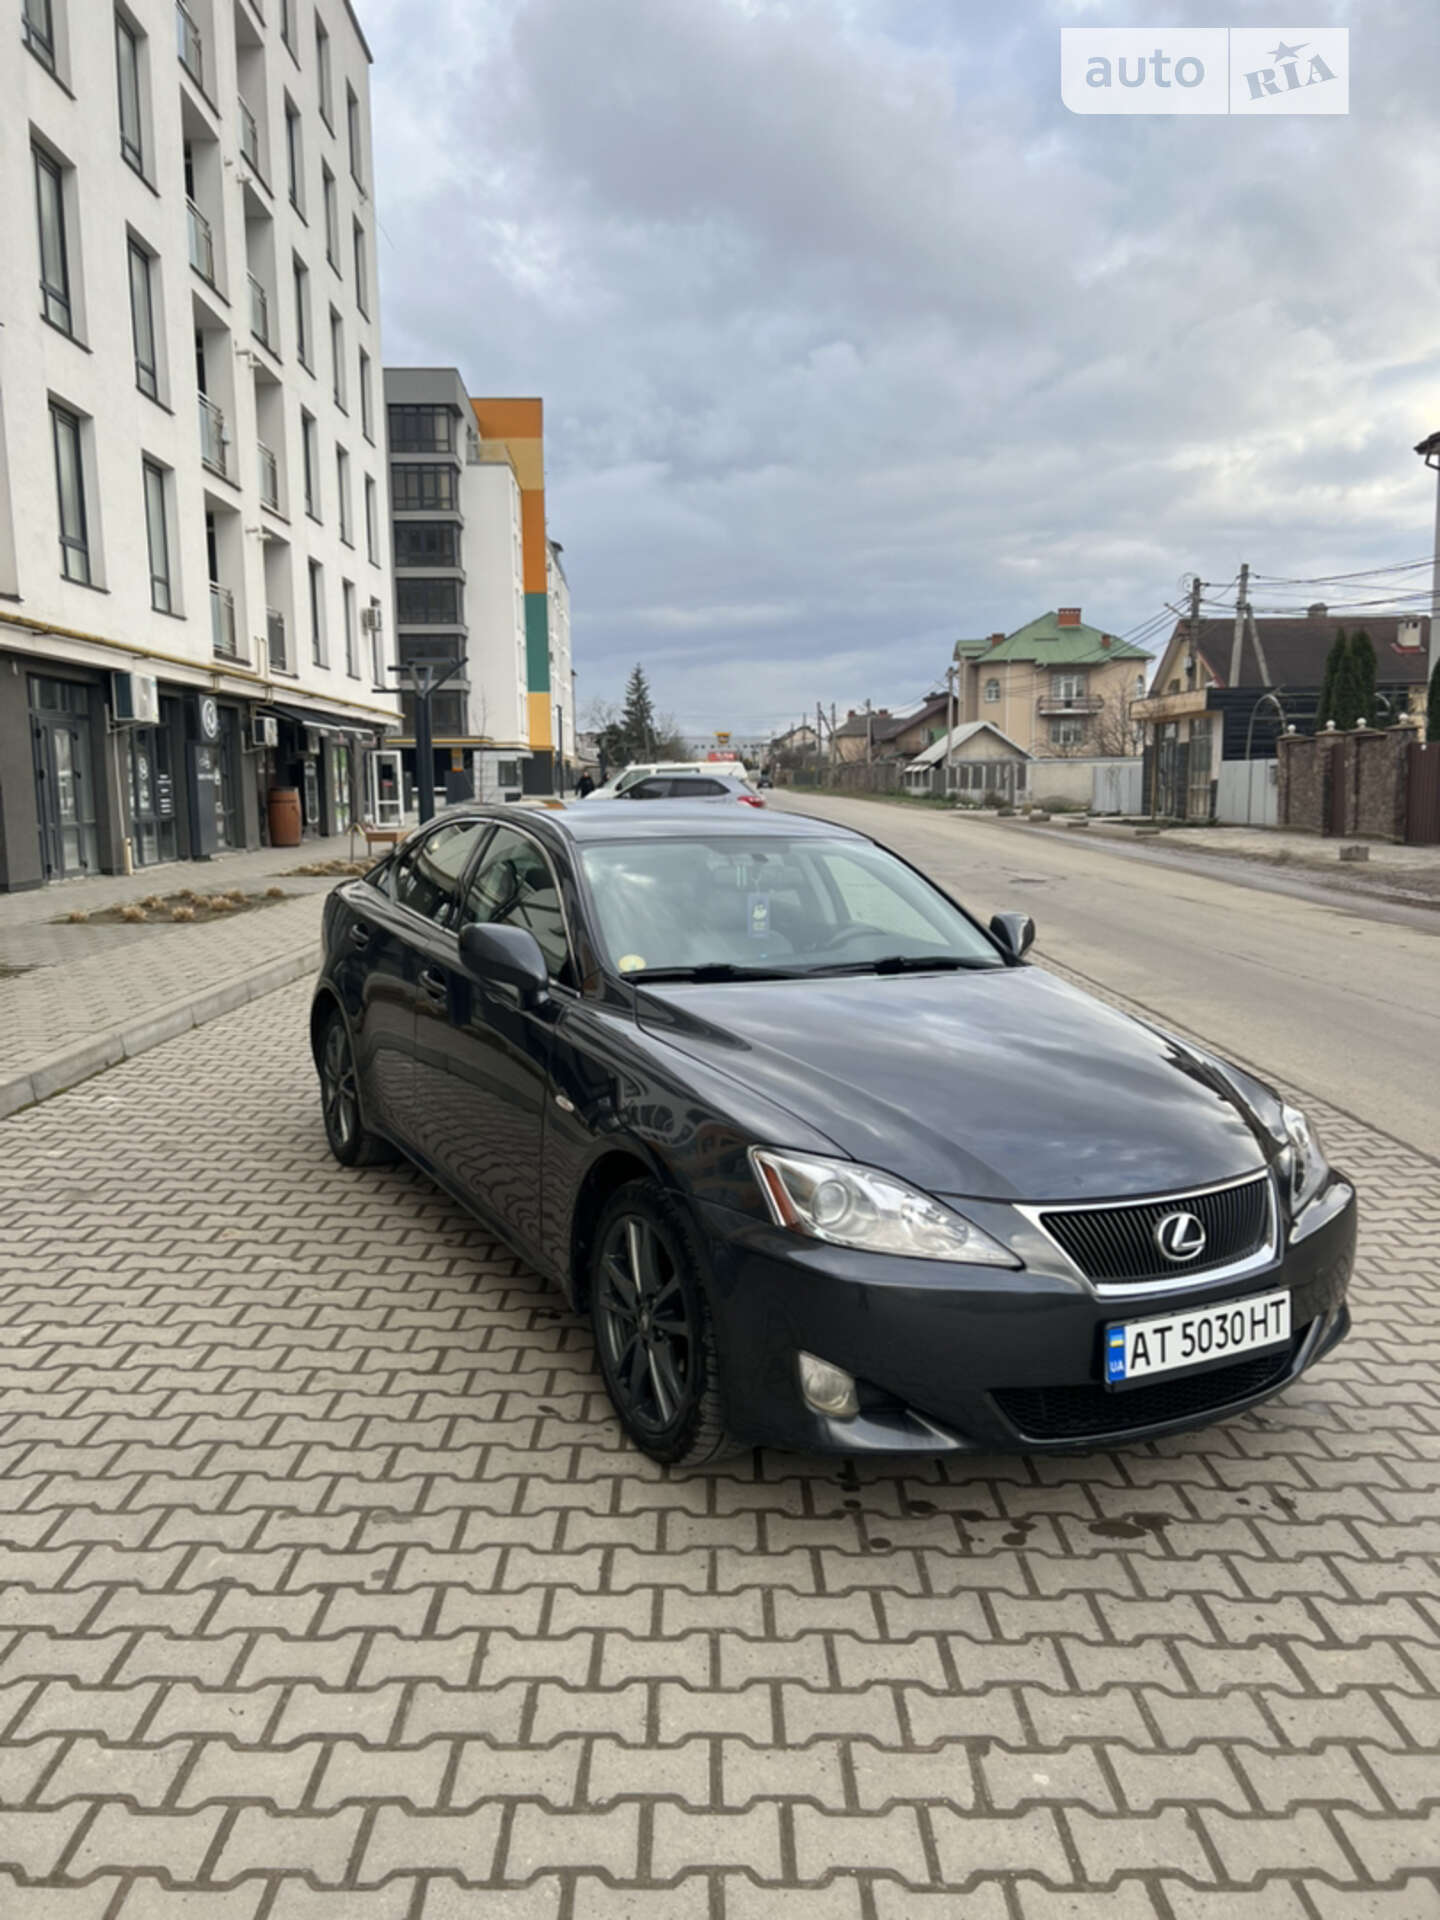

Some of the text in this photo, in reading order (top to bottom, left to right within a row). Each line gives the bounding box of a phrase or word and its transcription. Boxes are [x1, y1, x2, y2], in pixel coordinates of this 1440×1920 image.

[1130, 1299, 1286, 1369] AT 5030 HT
[1109, 1360, 1124, 1374] UA
